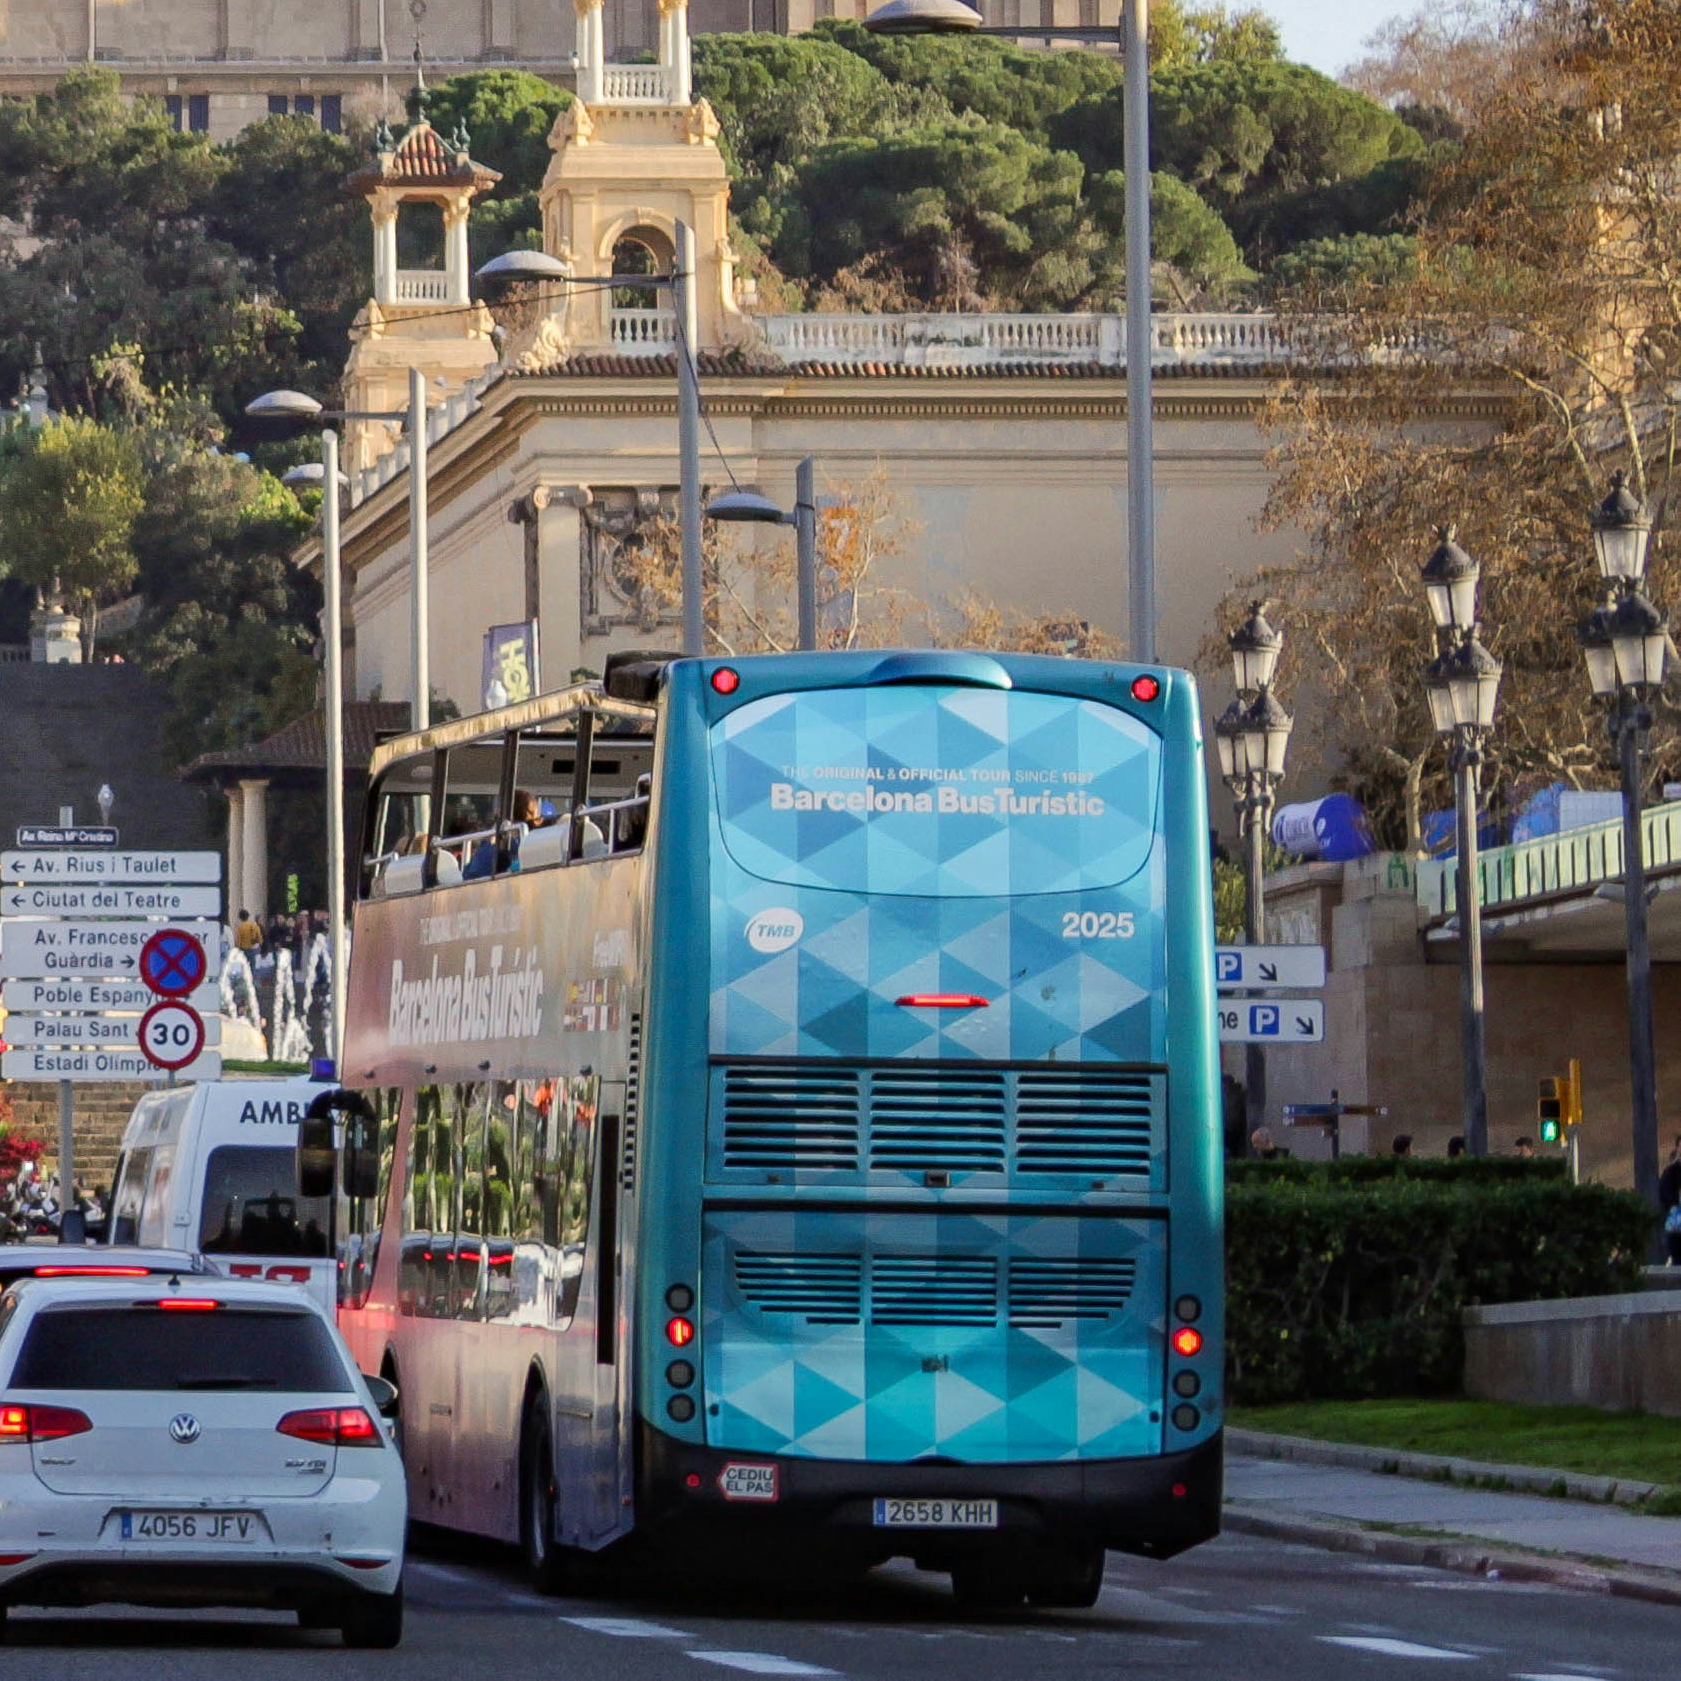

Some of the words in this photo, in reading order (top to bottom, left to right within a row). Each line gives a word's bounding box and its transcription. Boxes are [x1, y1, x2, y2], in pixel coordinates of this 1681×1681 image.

[782, 765, 809, 779] THE
[813, 766, 885, 780] ORIGINAL
[887, 768, 896, 780] &
[898, 767, 967, 781] OFFICIAL
[971, 769, 1011, 782] TOUR
[1014, 769, 1058, 783] SINCE
[770, 782, 933, 812] Barcelona
[937, 786, 1105, 816] BusTurístic
[33, 857, 60, 873] Av.
[66, 857, 105, 873] Rius
[111, 857, 116, 873] i
[123, 856, 177, 873] Taulet
[32, 891, 86, 908] Ciutat
[92, 891, 118, 908] del
[125, 891, 181, 908] Teatre
[757, 924, 796, 938] TMB
[1061, 912, 1136, 938] 2025
[35, 929, 61, 945] Av.
[68, 928, 148, 945] Francesc
[44, 951, 113, 969] Guàrdia
[34, 986, 83, 1003] Poble
[389, 954, 462, 1047] Barcelona
[34, 1021, 82, 1037] Palau
[89, 1021, 129, 1037] Sant
[152, 1022, 190, 1046] 30
[34, 1054, 88, 1071] Estadi
[726, 1468, 774, 1482] CEDIU
[726, 1481, 743, 1492] EL
[746, 1481, 774, 1493] PAS
[889, 1502, 943, 1523] 2658
[951, 1503, 992, 1524] KHH
[138, 1515, 197, 1537] 4056
[205, 1517, 251, 1538] JFV
